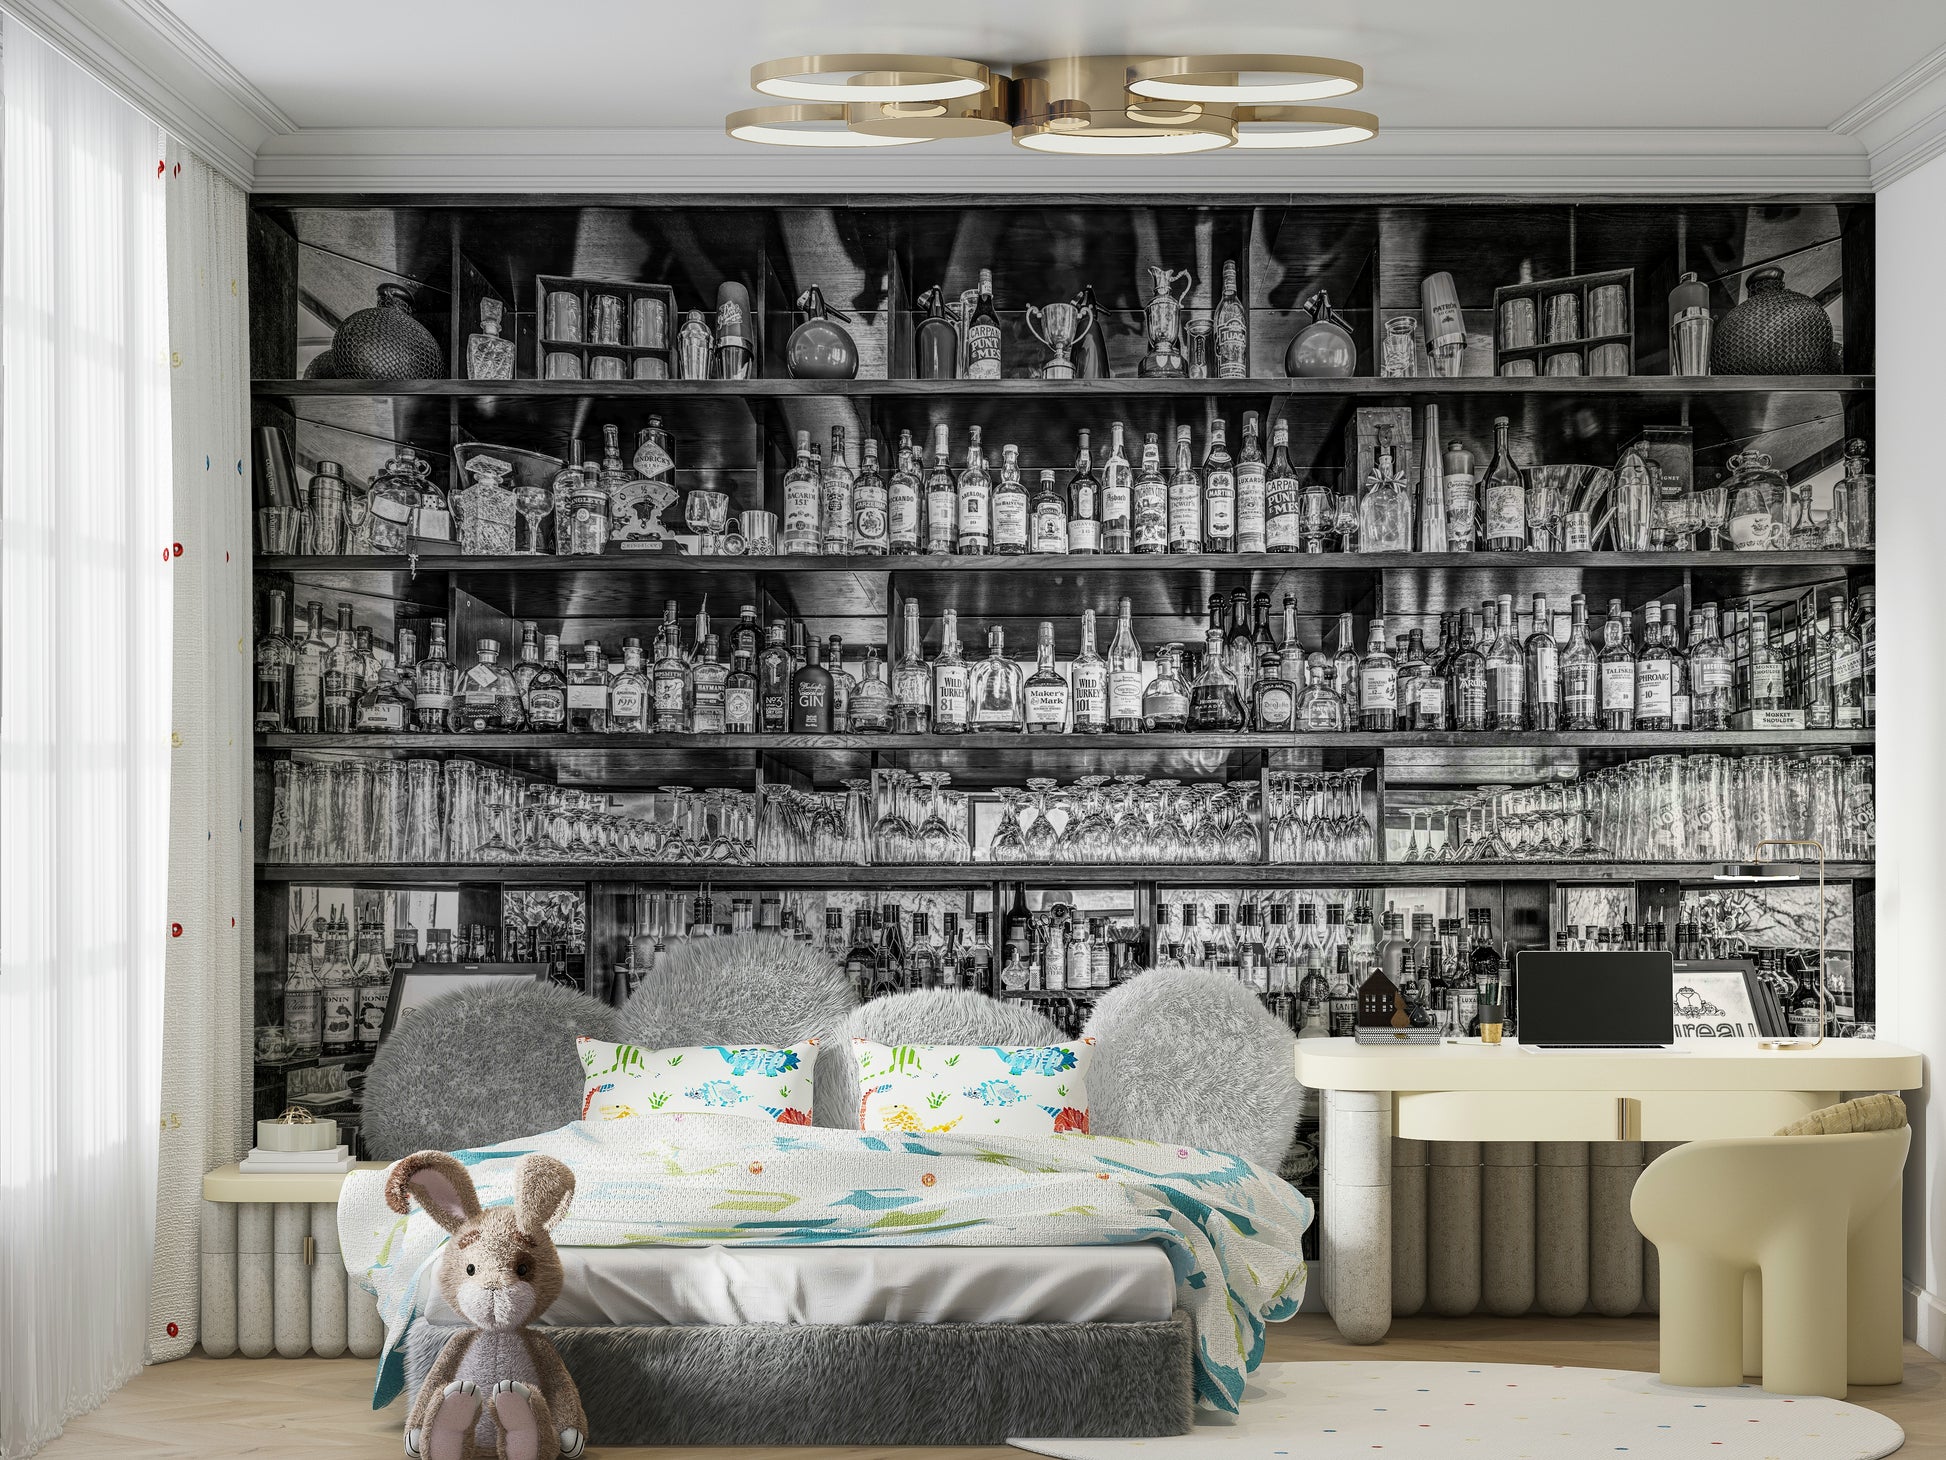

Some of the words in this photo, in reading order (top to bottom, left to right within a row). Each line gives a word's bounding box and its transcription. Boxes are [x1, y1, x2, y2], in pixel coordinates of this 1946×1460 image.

[971, 338, 999, 352] PUNT
[977, 348, 1000, 359] MES
[1268, 492, 1296, 507] PUNT
[1273, 502, 1298, 514] MES
[944, 677, 962, 687] WILD
[1079, 679, 1097, 688] WILD
[940, 686, 966, 698] TURKEY
[1076, 688, 1101, 698] TURKEY
[1645, 689, 1653, 698] 10
[799, 695, 824, 707] GIN
[940, 699, 953, 711] 81
[1040, 697, 1064, 705] Mark
[1076, 700, 1090, 712] 101
